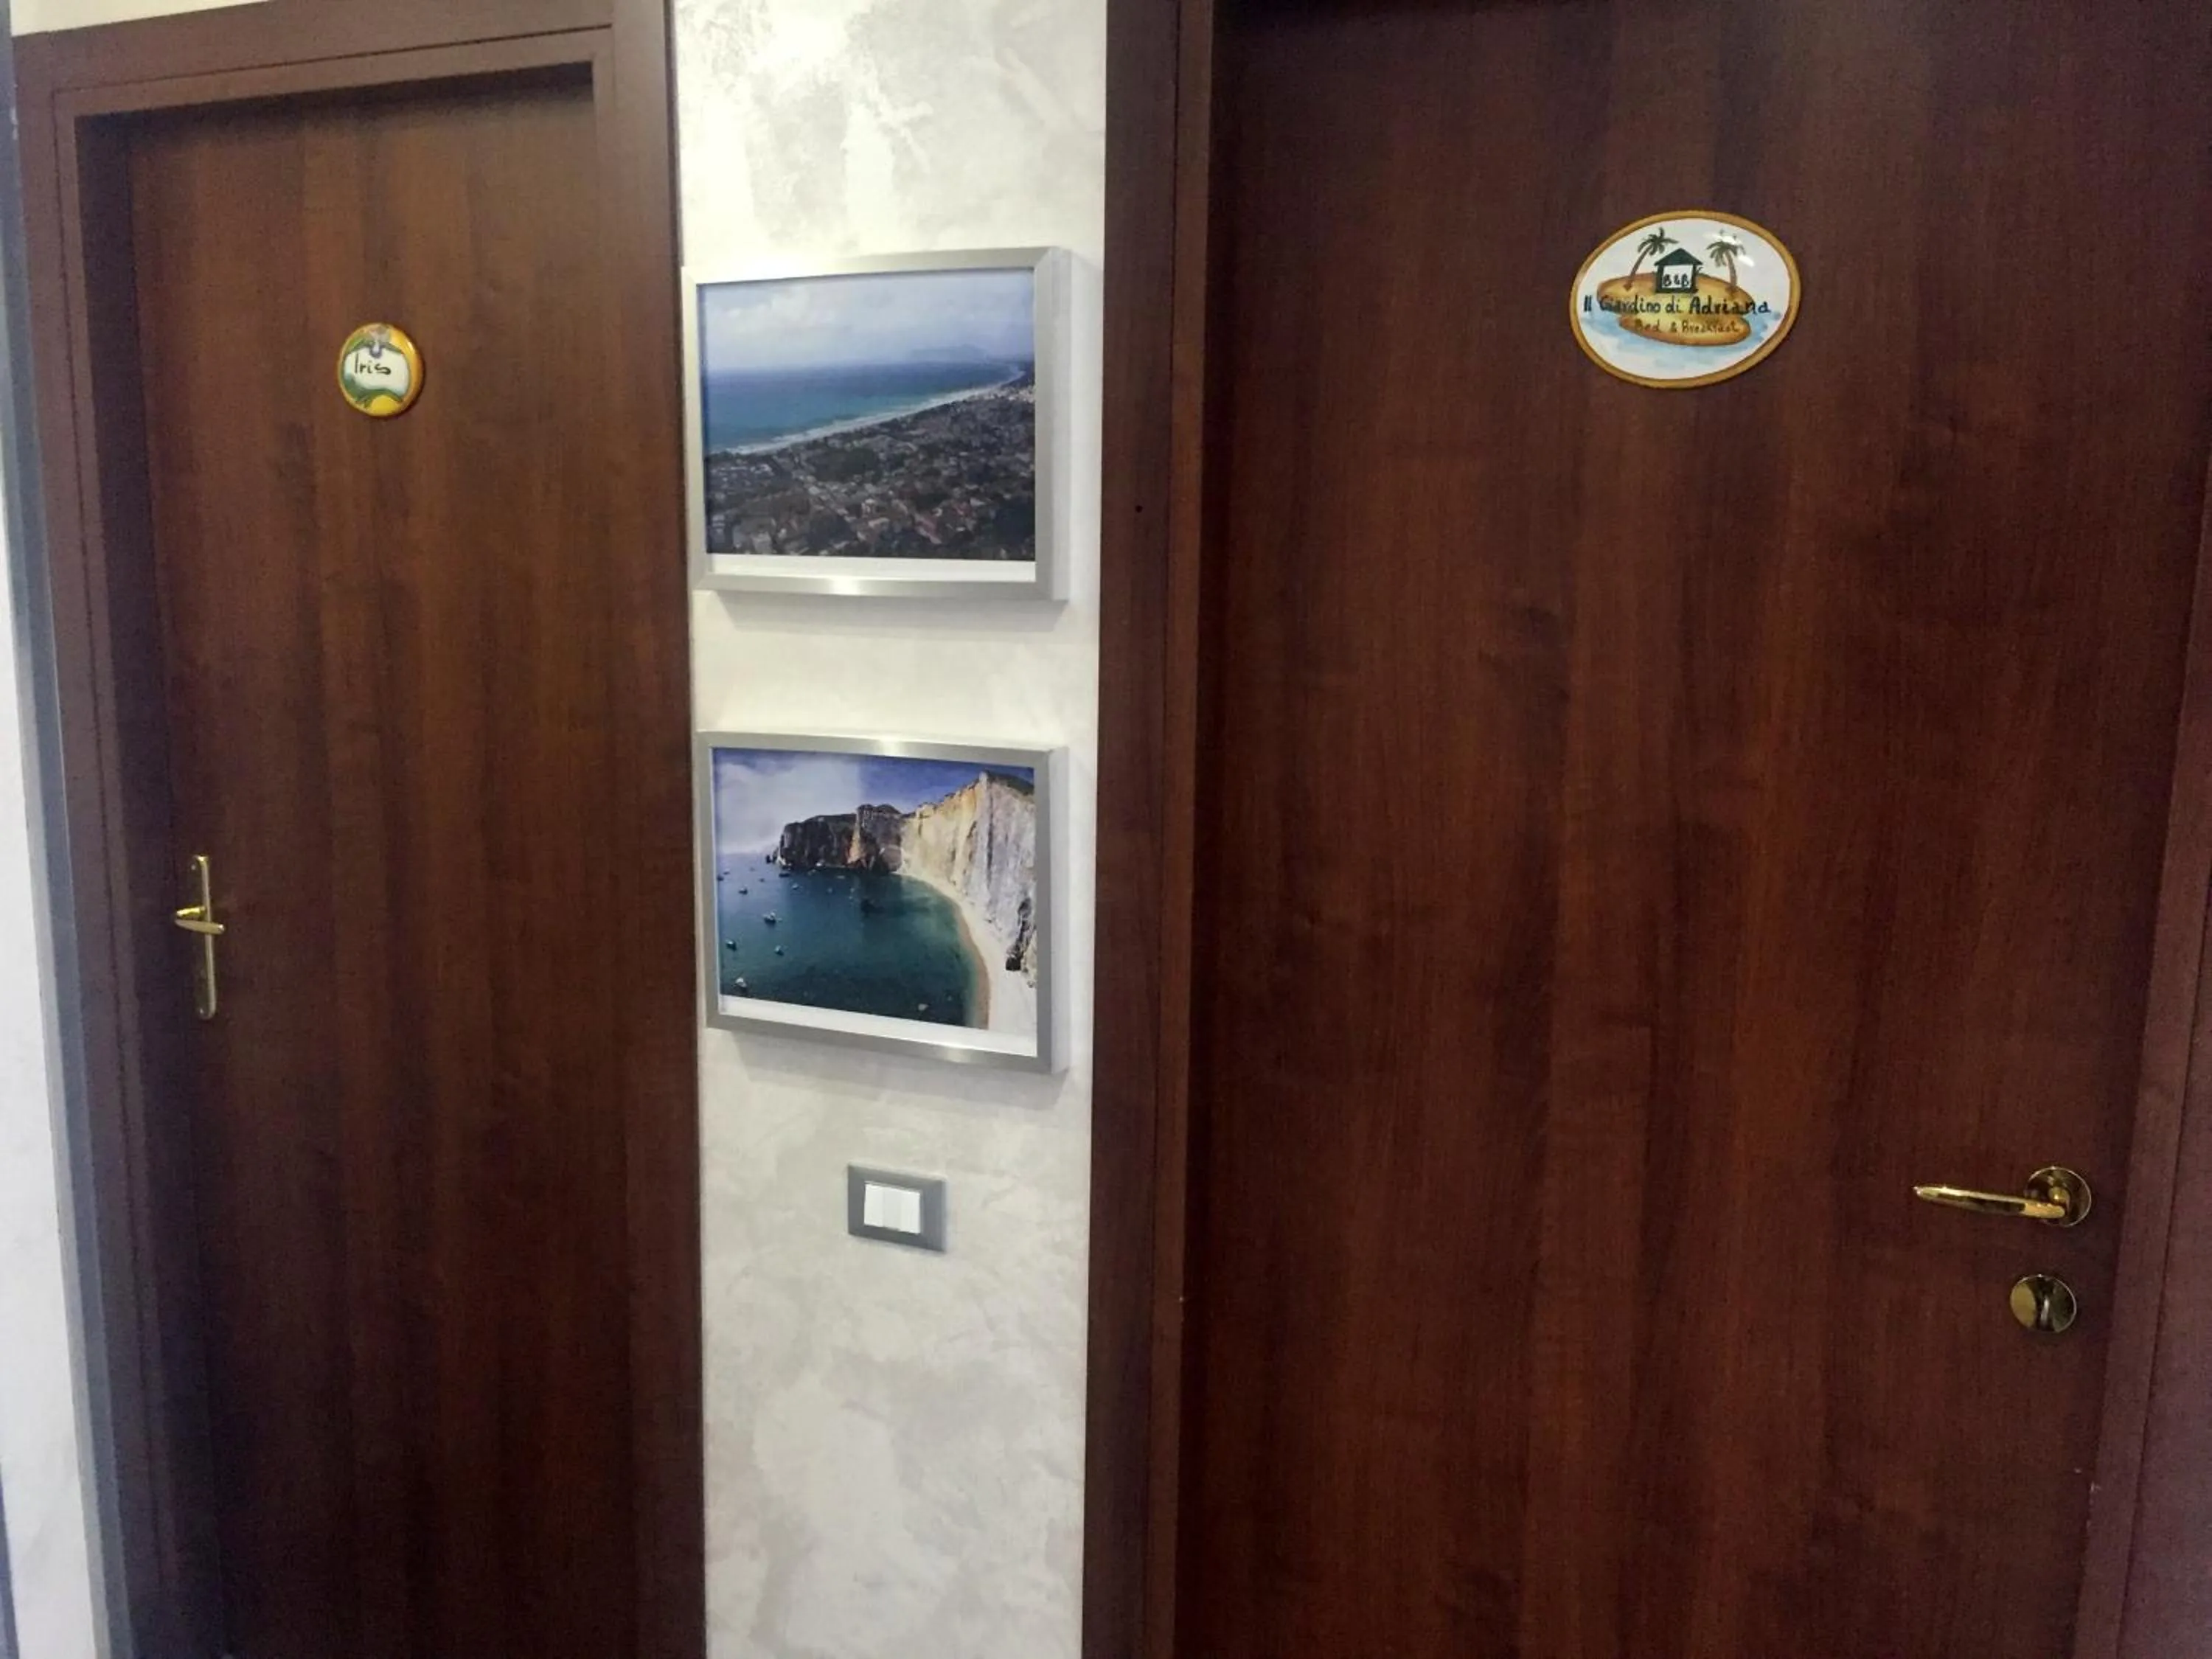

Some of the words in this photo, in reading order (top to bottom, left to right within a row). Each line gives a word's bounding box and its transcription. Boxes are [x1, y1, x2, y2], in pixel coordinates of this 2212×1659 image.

[1665, 296, 1682, 313] di
[1689, 295, 1771, 316] Adriana
[354, 353, 392, 375] Iris
